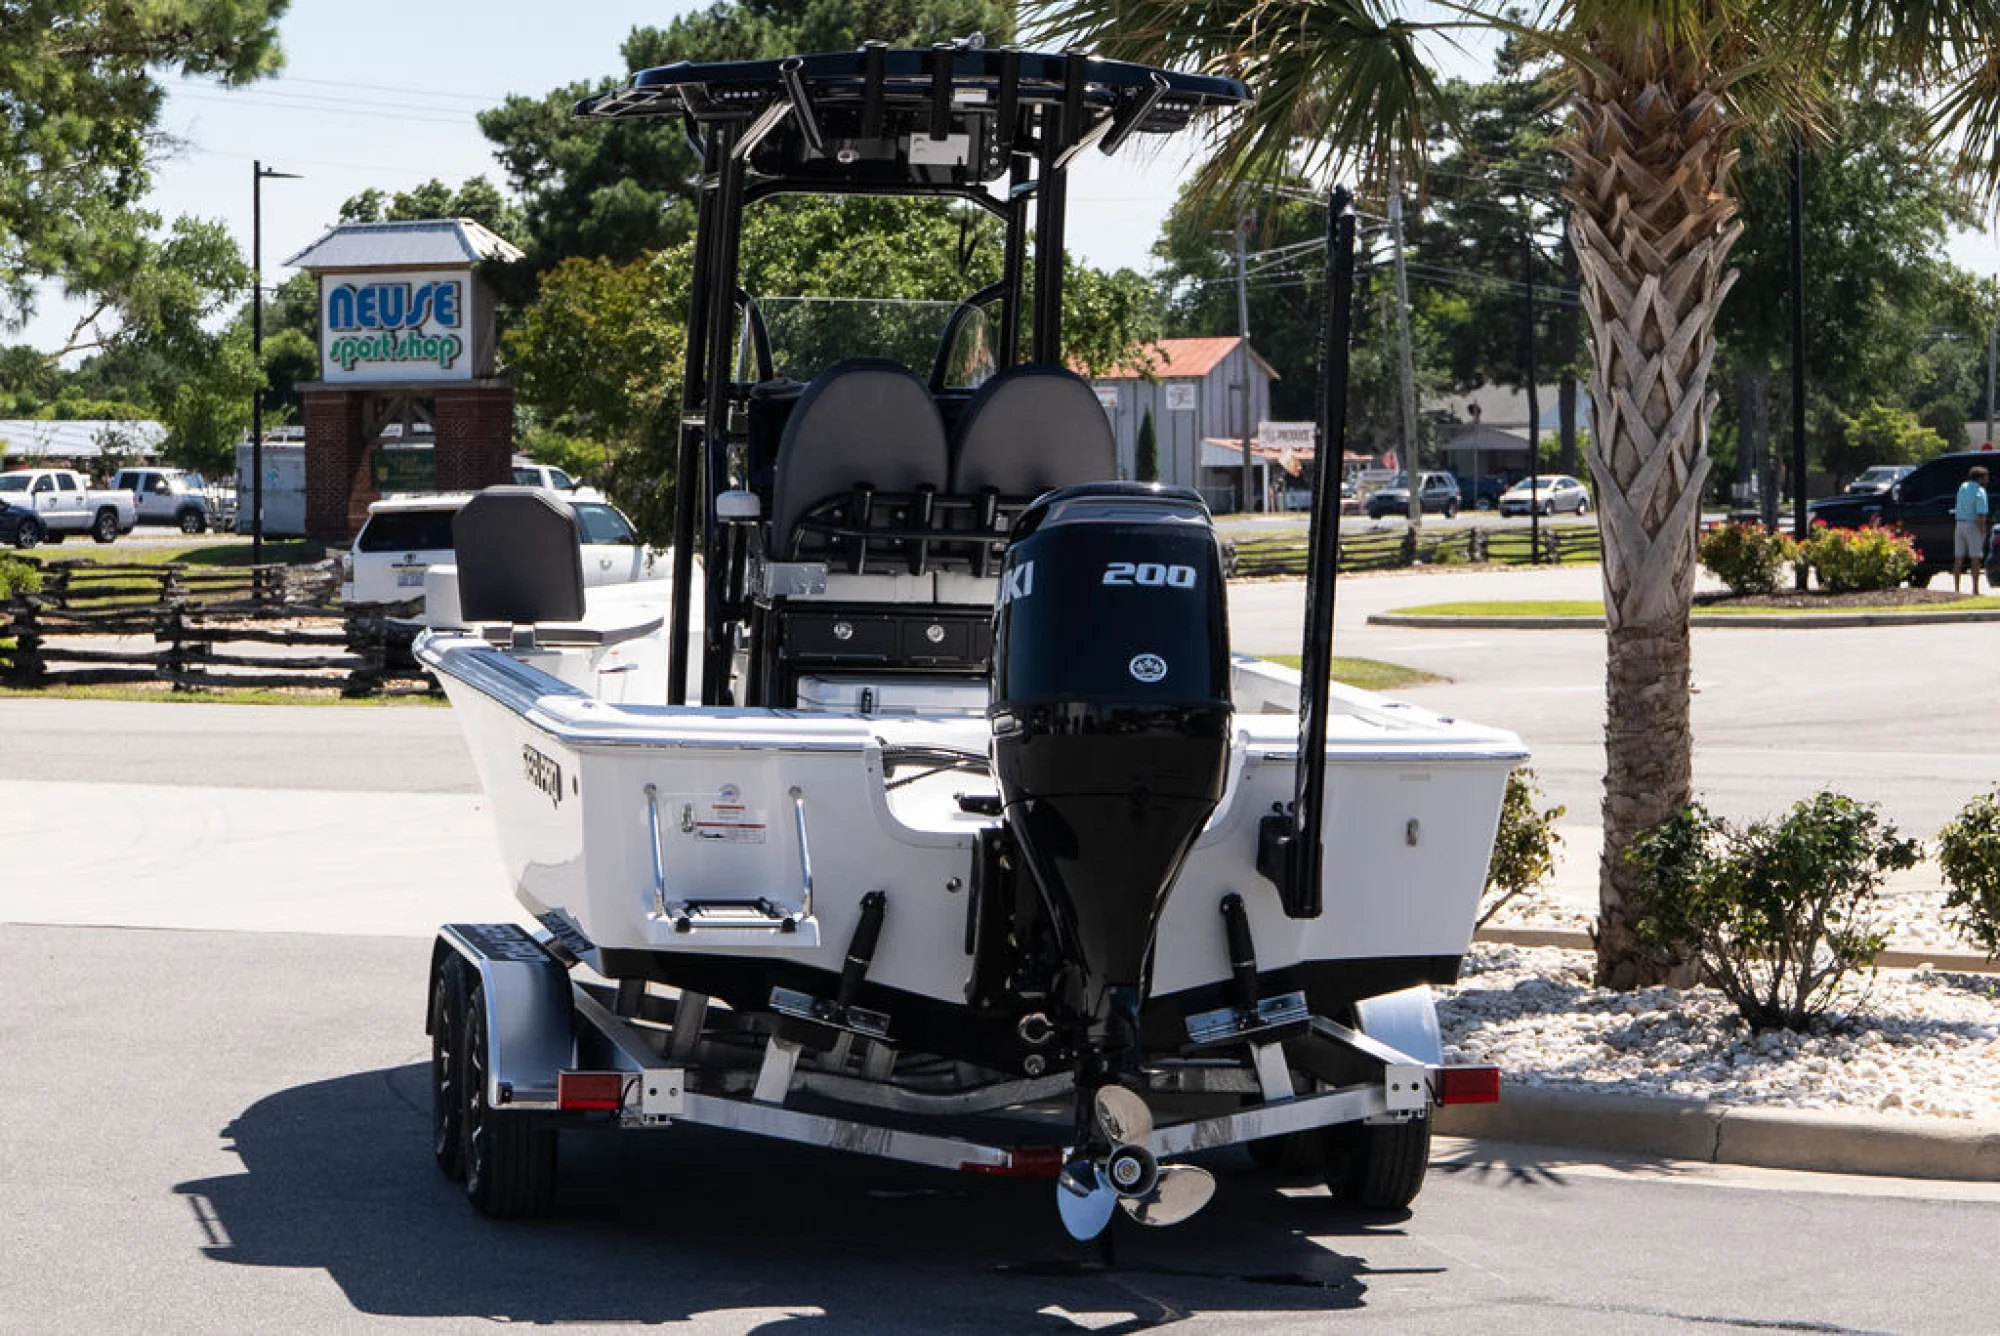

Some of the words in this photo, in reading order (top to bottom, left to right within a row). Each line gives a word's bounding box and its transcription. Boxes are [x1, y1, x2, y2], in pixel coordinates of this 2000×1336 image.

[329, 283, 457, 329] NEUSE
[329, 330, 391, 369] sport
[395, 330, 456, 368] shop
[1003, 560, 1034, 604] KI
[1102, 561, 1197, 588] 200
